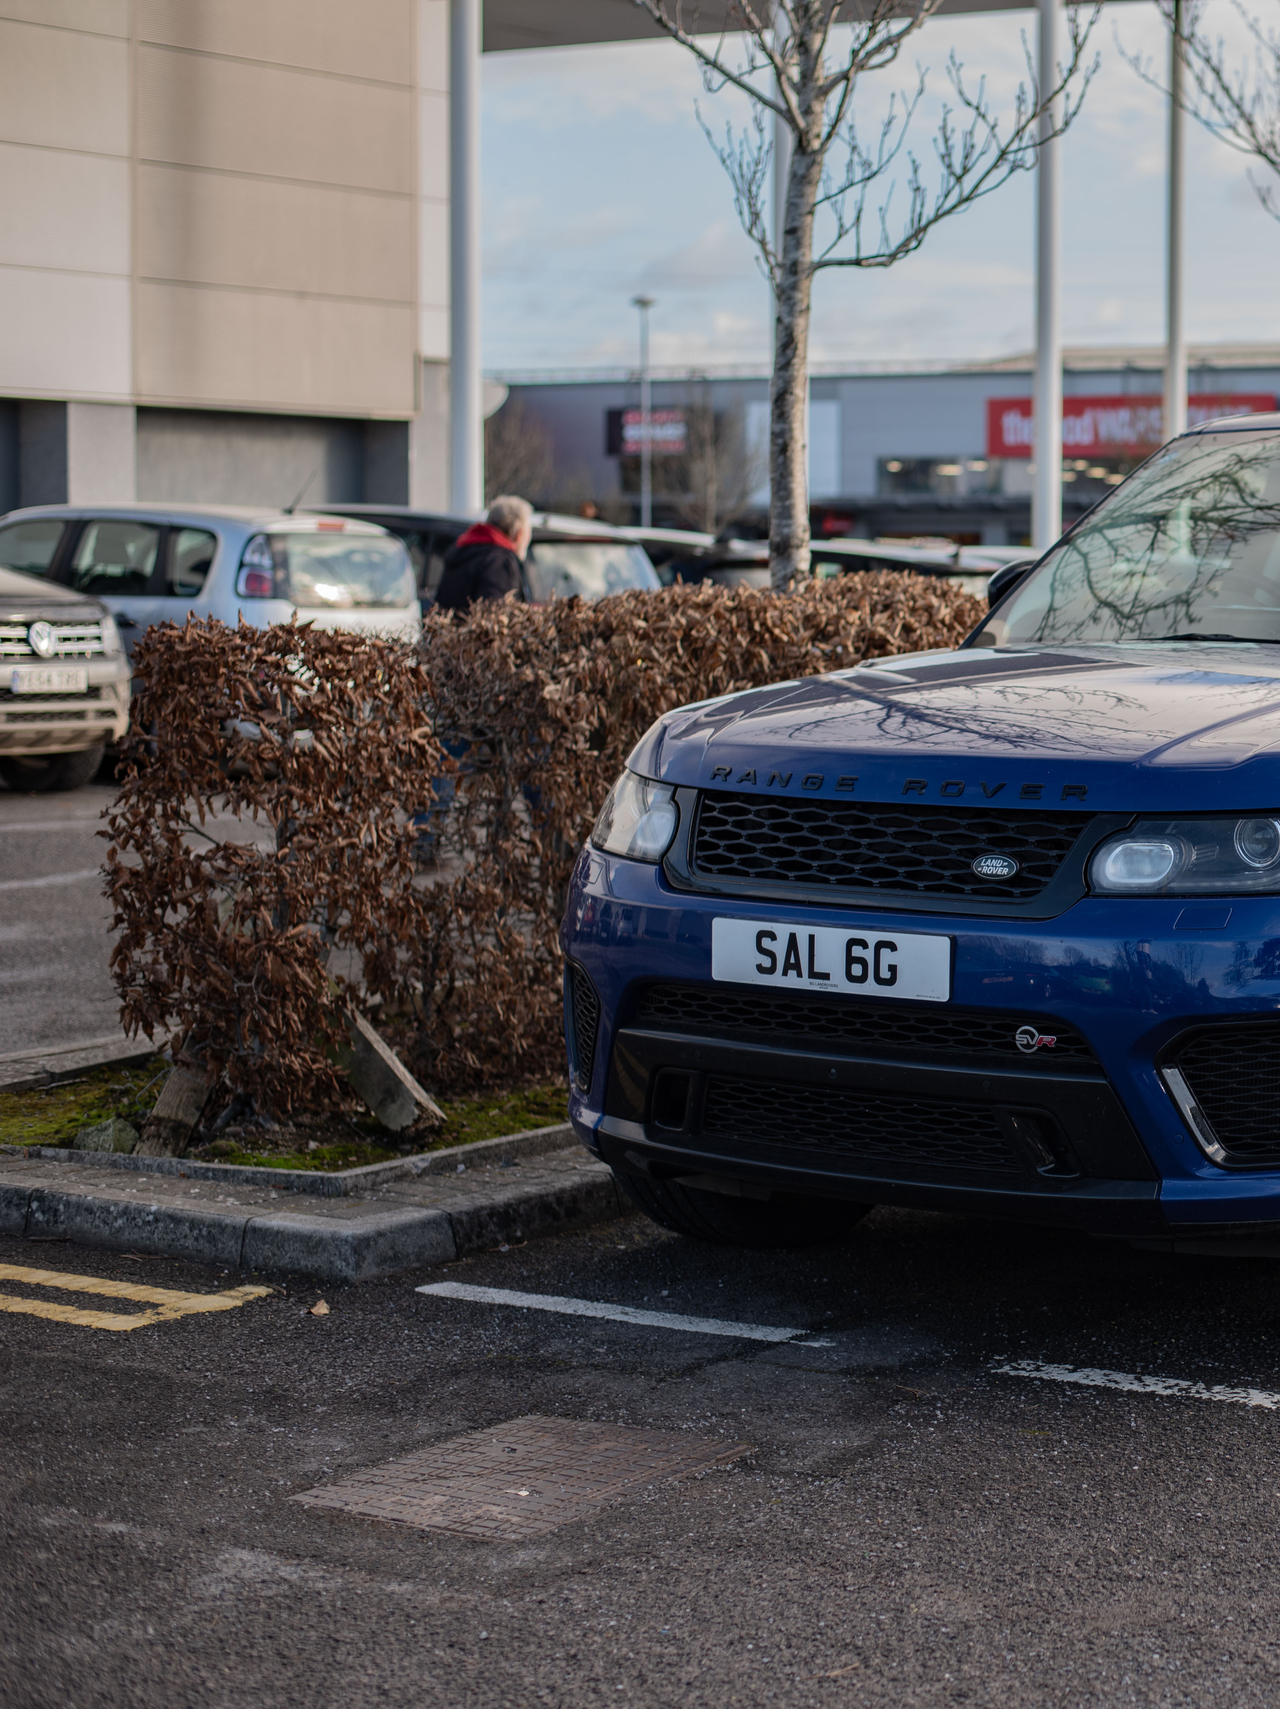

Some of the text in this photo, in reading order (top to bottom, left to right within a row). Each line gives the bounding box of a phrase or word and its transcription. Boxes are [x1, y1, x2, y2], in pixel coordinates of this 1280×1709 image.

[710, 765, 1089, 802] RANGE ROVER
[981, 859, 1003, 867] LAND
[981, 866, 1009, 875] ROVER
[755, 930, 898, 986] SAL 6G
[1015, 1031, 1057, 1049] SVR
